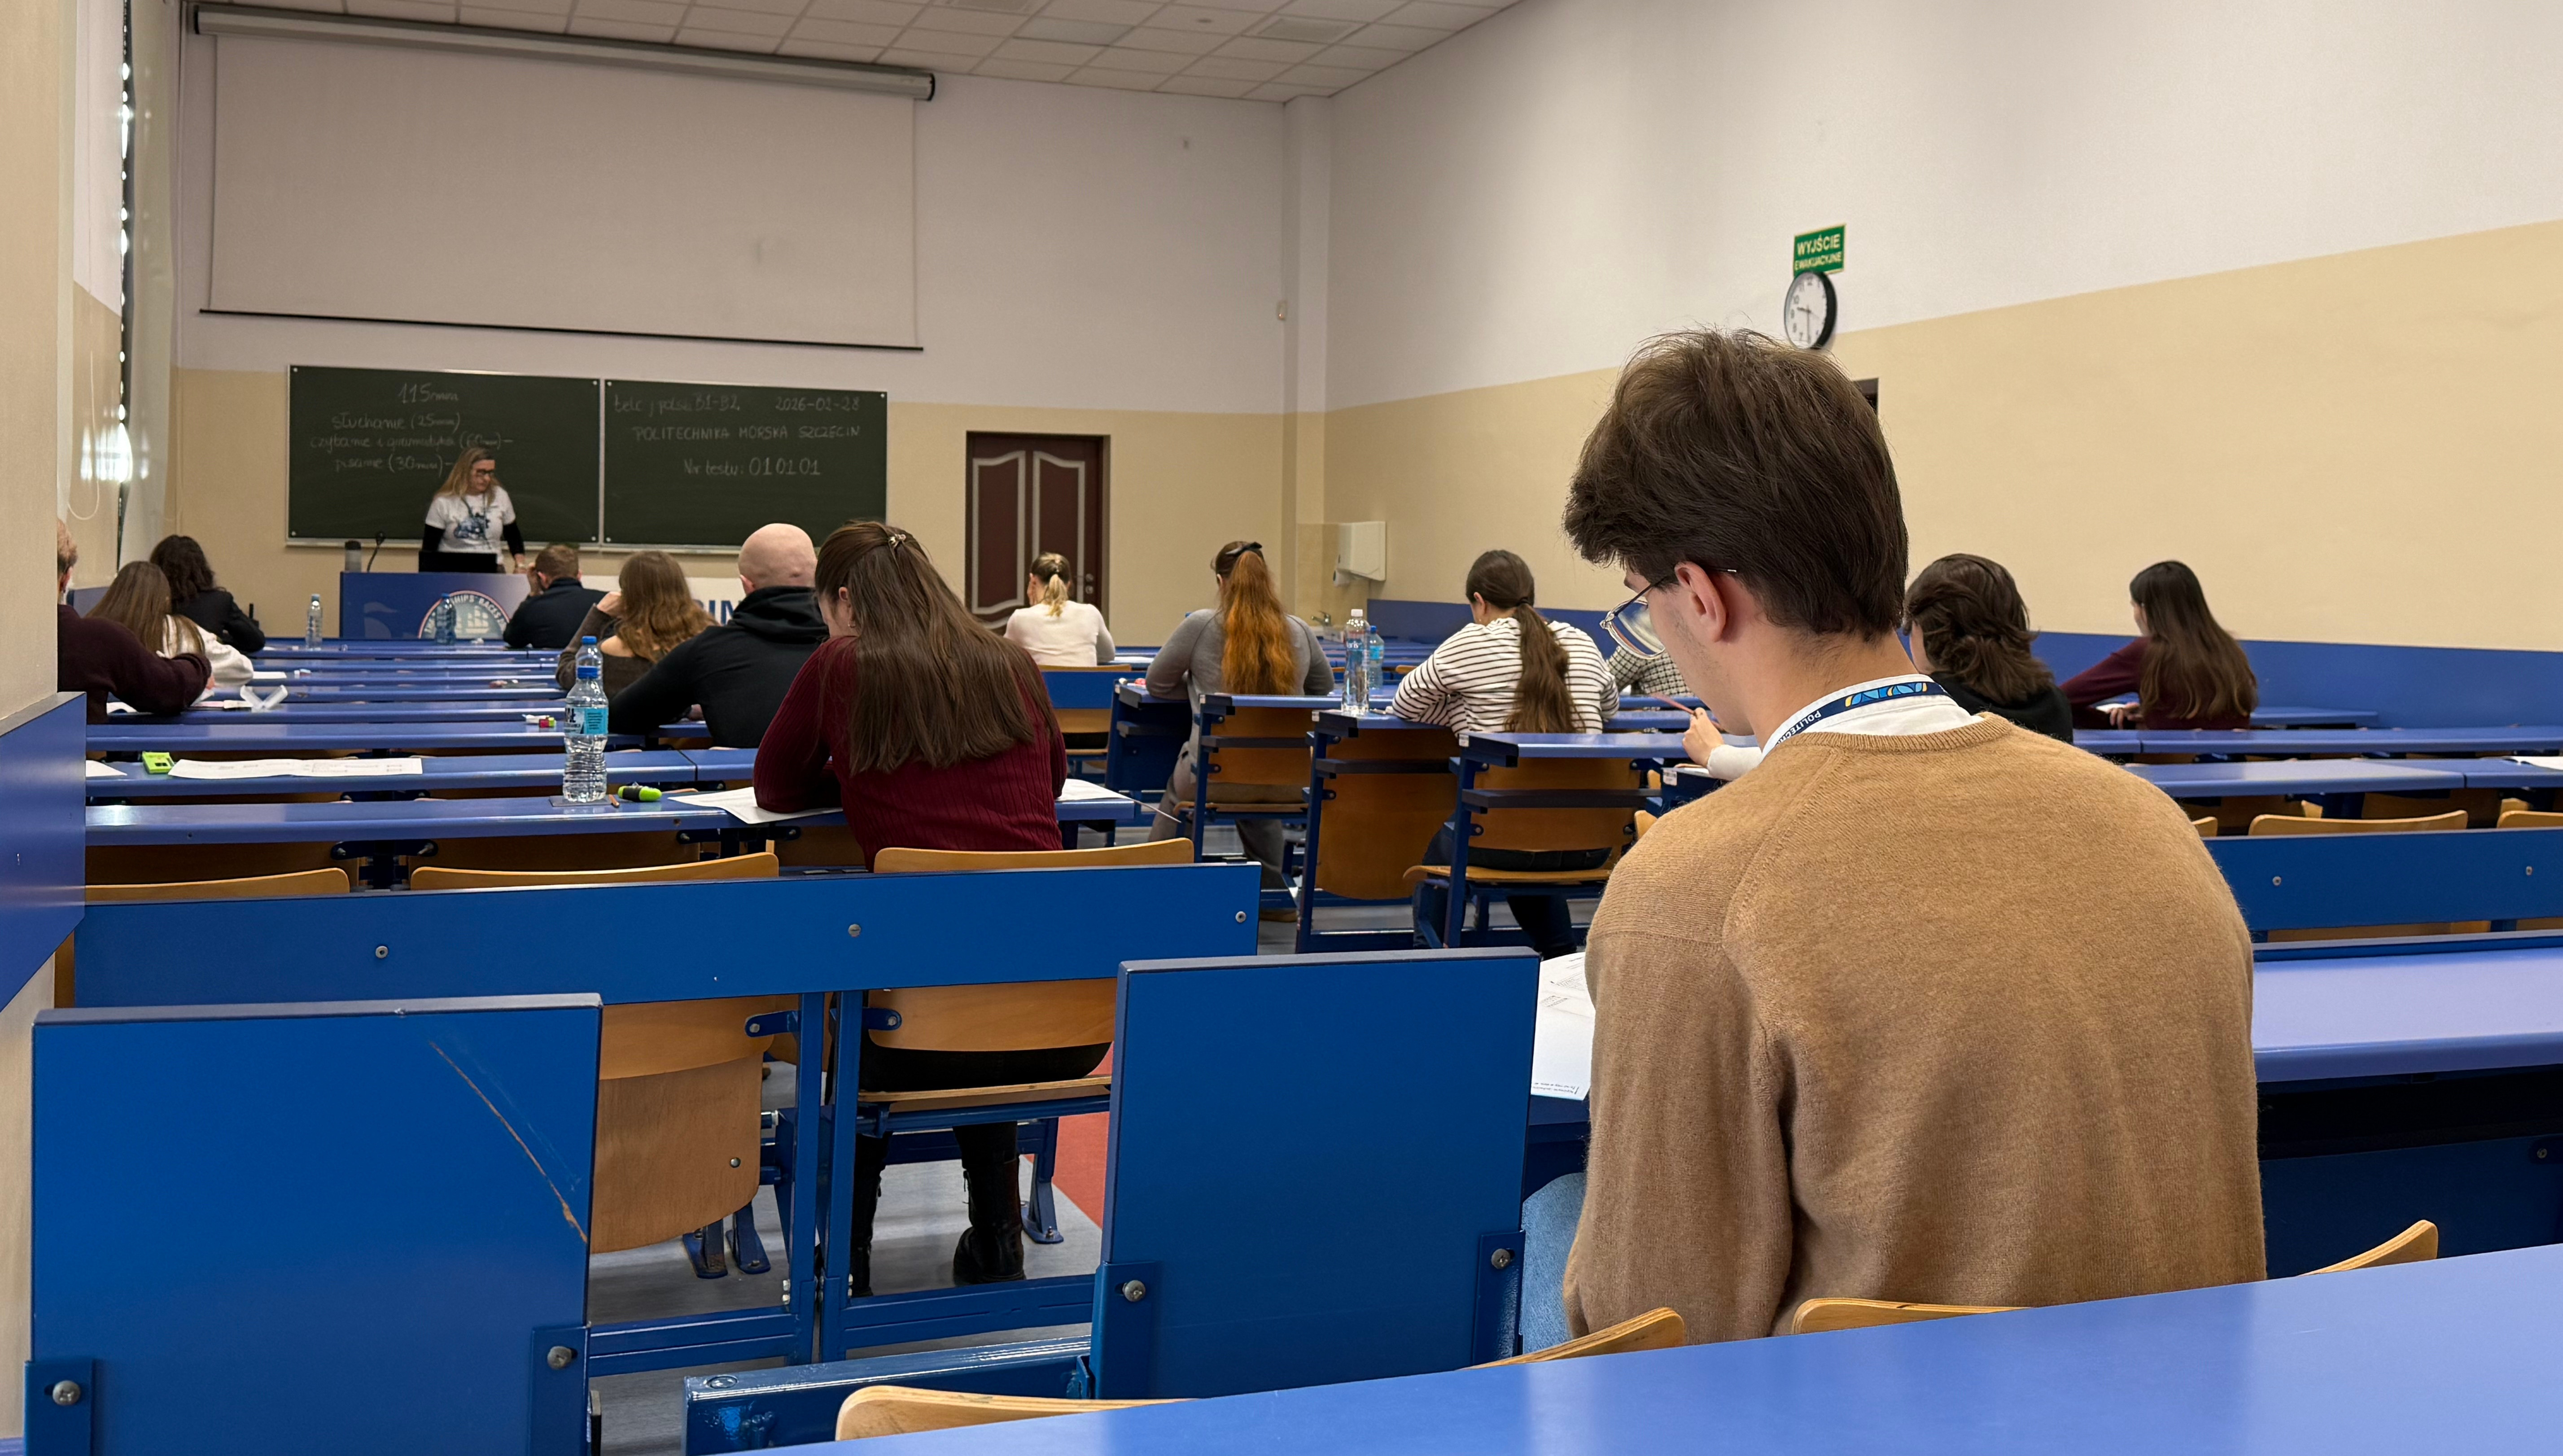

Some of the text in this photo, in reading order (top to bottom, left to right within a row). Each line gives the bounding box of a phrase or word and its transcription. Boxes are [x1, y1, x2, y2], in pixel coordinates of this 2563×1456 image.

[1797, 234, 1840, 256] WYJŚCIE
[632, 425, 861, 442] POLITECHNIKA MORSKA SZCZECIN
[1777, 710, 1822, 744] POLITECH
